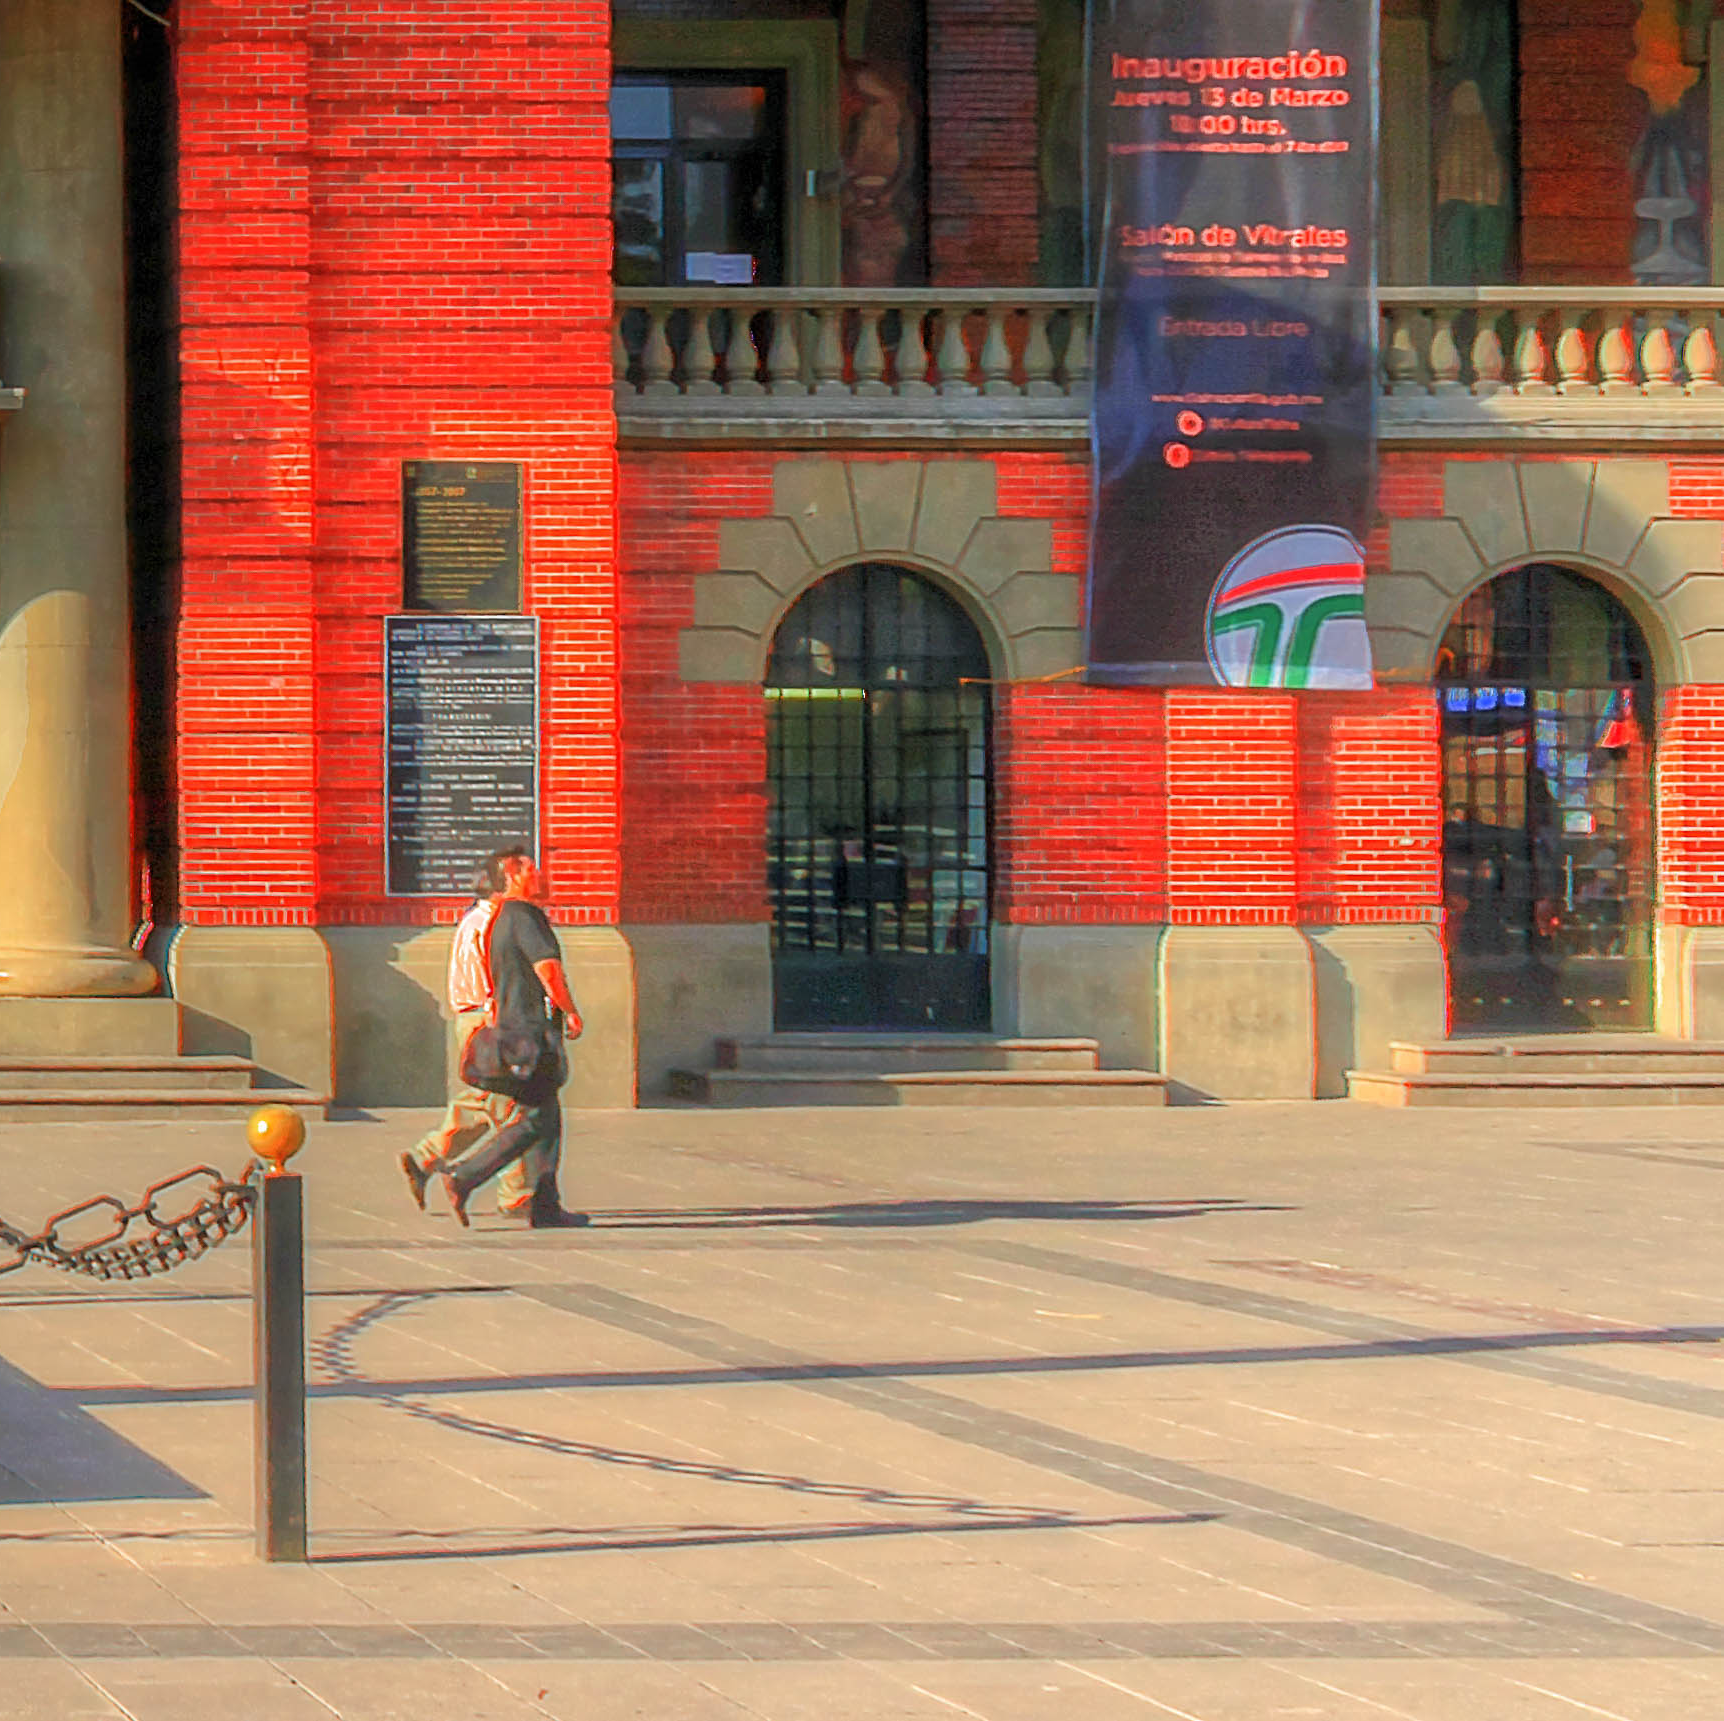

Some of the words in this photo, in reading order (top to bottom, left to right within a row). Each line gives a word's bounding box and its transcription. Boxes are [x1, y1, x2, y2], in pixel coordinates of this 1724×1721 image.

[1111, 48, 1348, 84] Inauguración
[1230, 87, 1264, 107] de
[1268, 87, 1350, 107] Marzo
[1240, 115, 1288, 135] hrs.
[1201, 223, 1238, 247] de
[1242, 223, 1349, 248] Vitrales
[1159, 316, 1246, 338] Entrada
